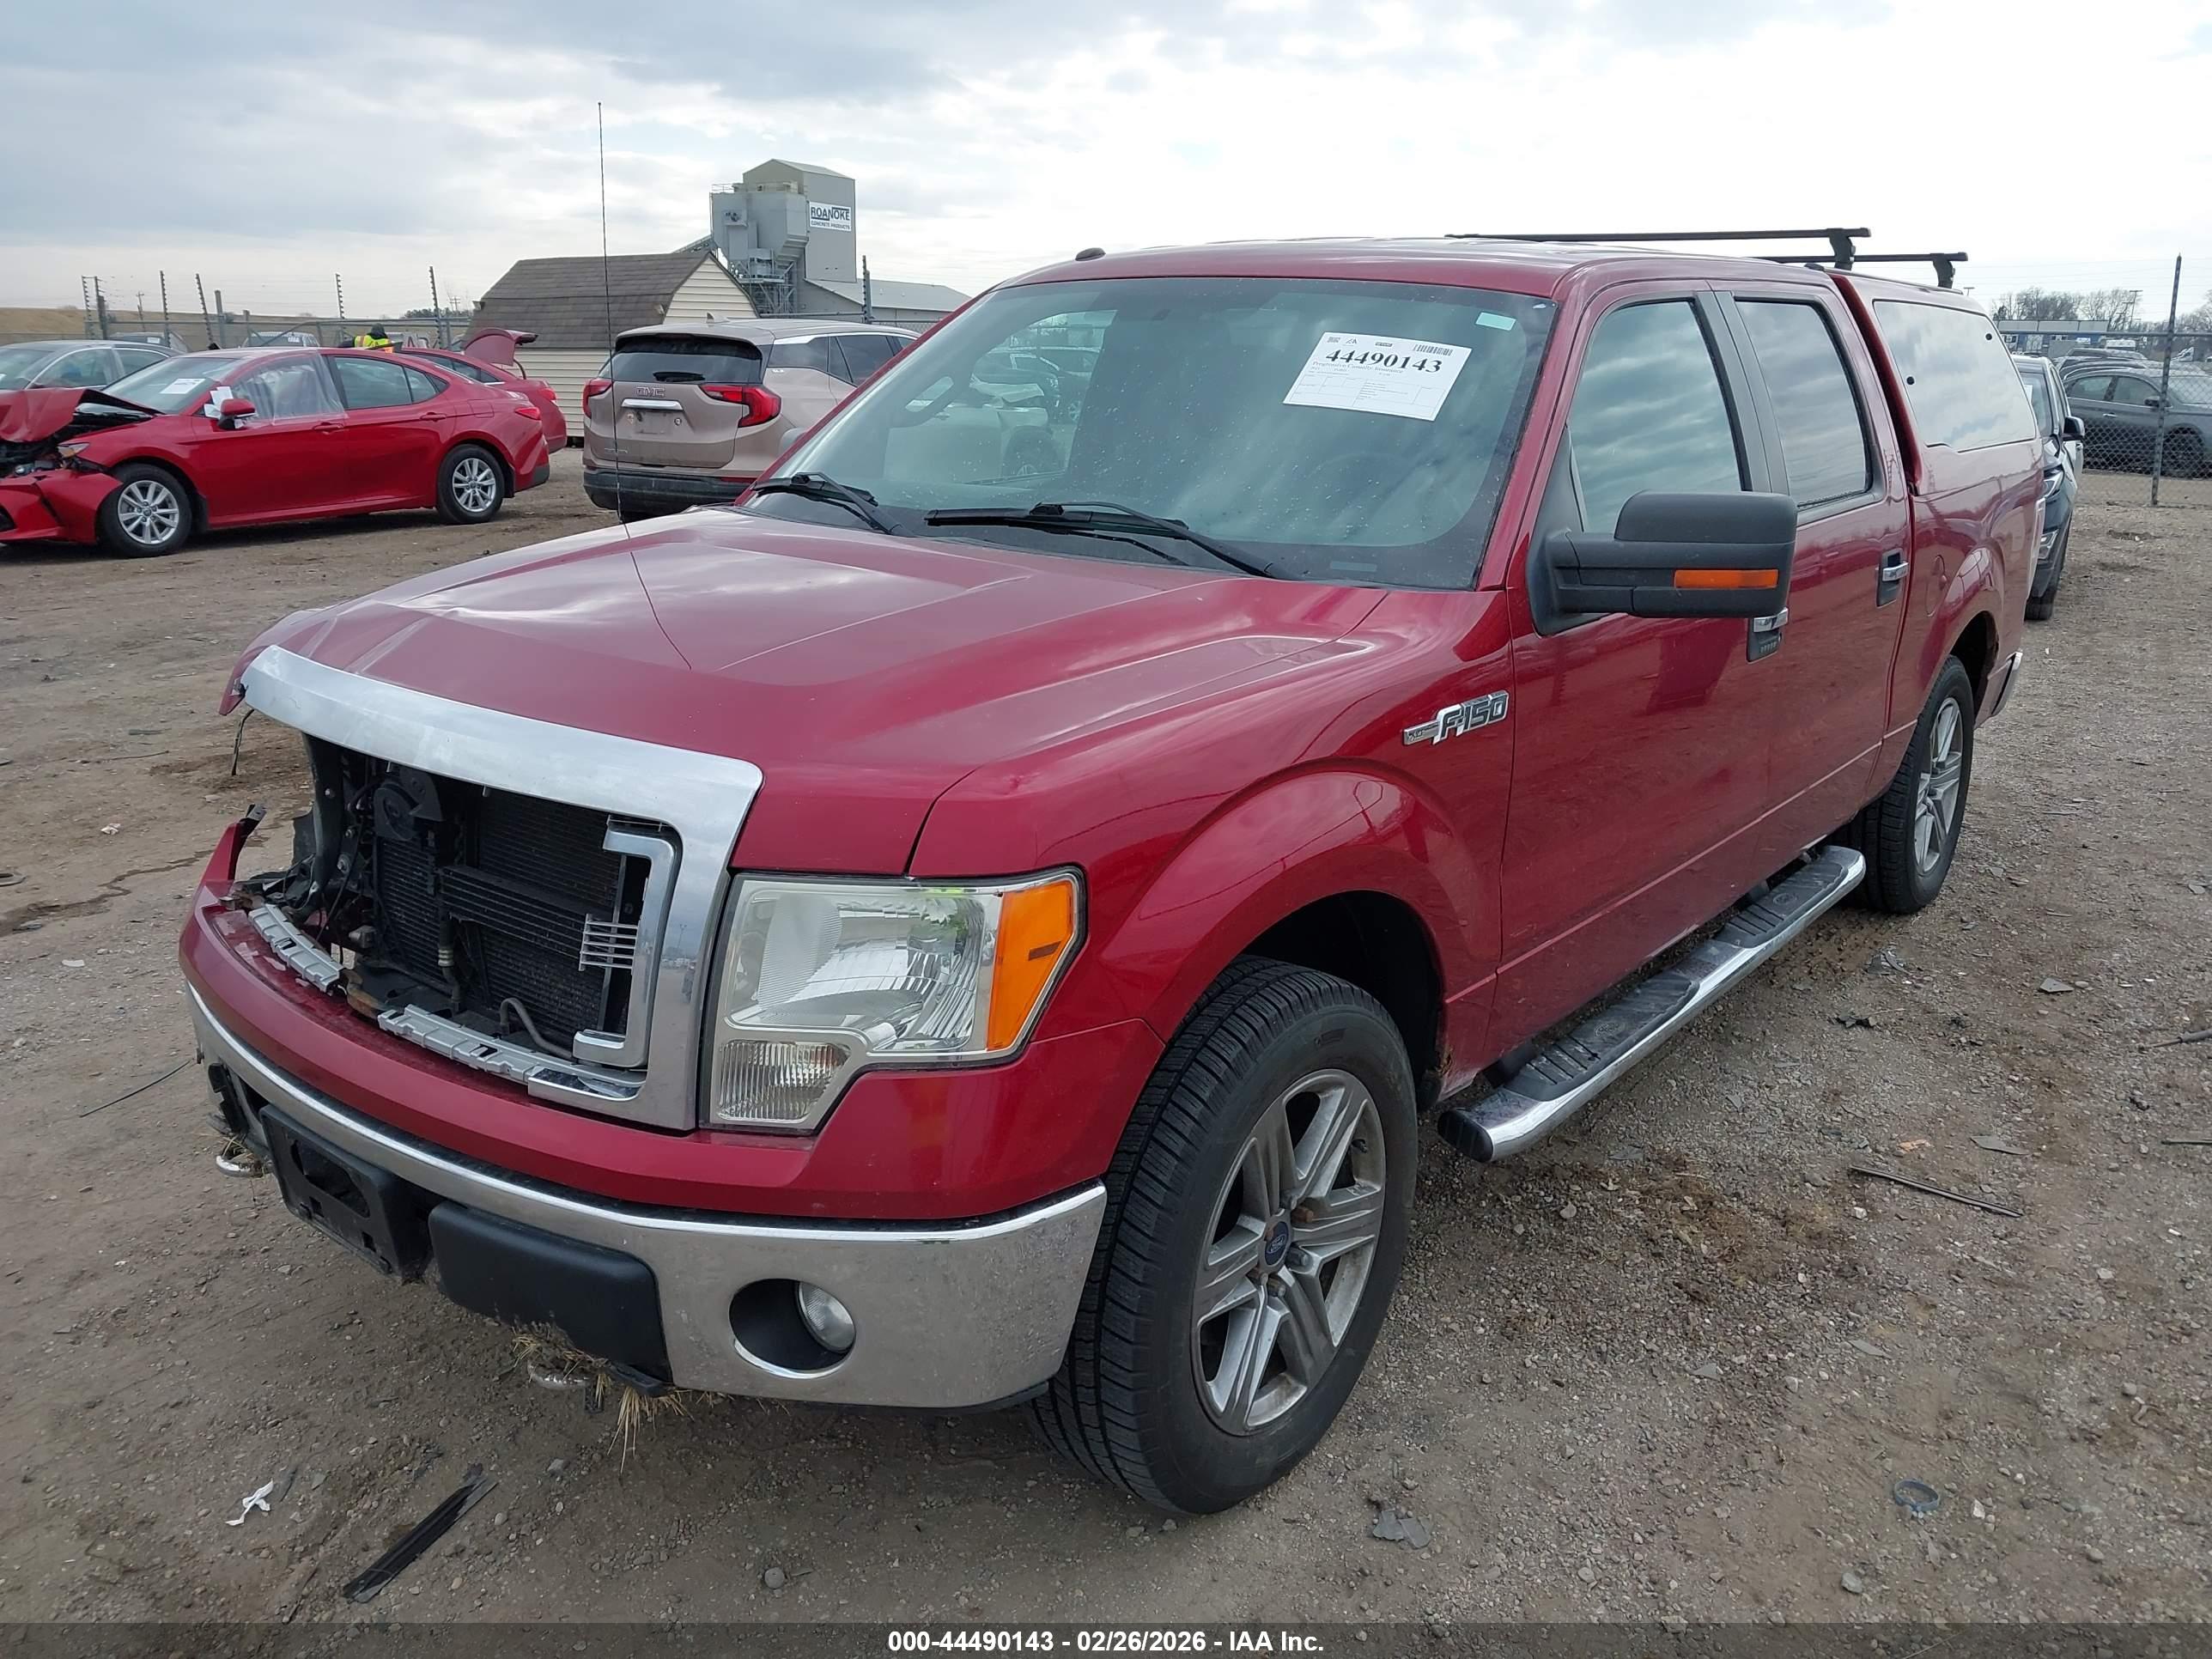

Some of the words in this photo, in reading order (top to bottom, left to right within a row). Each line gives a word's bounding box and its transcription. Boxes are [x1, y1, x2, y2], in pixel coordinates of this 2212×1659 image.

[811, 207, 850, 221] ROANOKE
[1325, 349, 1443, 374] 44490143
[635, 386, 665, 398] GMC
